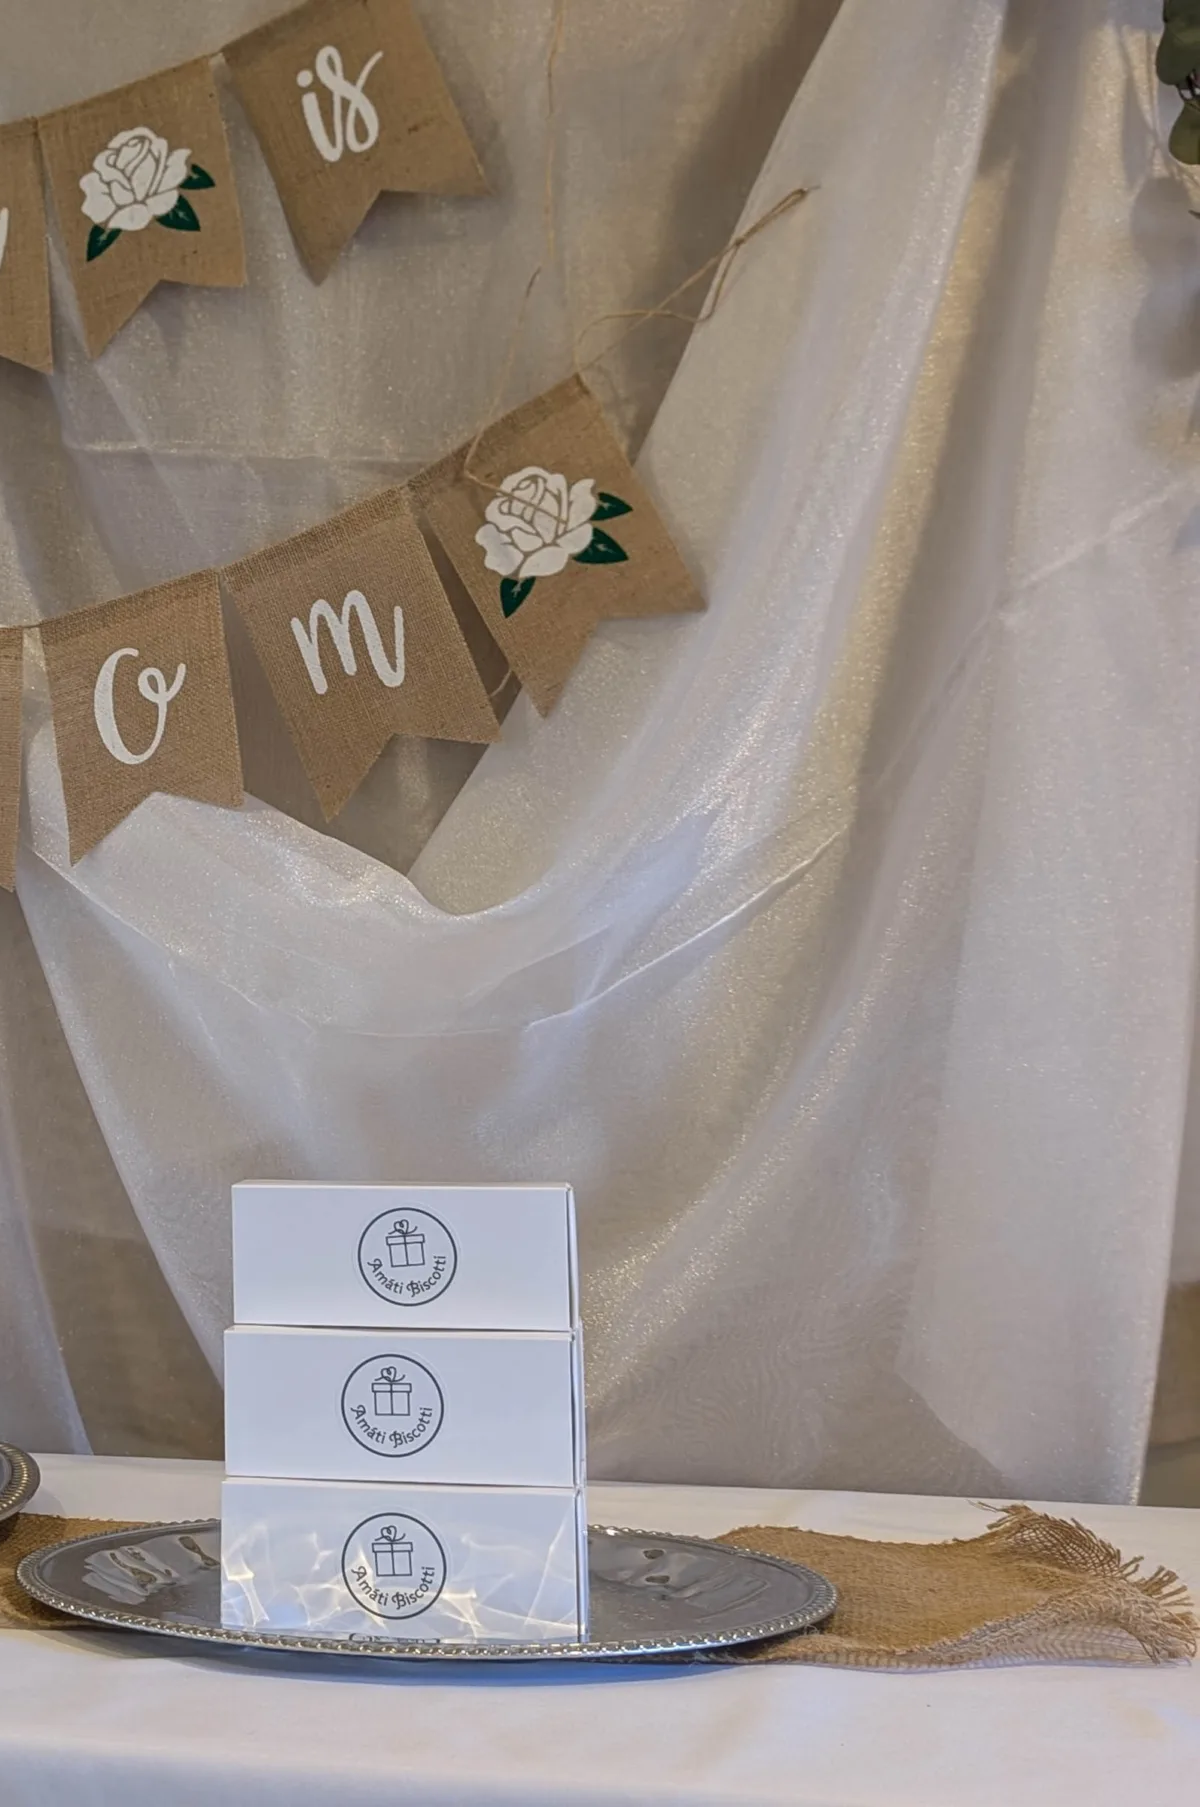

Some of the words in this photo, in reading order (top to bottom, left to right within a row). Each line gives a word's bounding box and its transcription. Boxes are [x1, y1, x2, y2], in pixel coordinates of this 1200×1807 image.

[297, 45, 384, 163] is
[406, 1255, 447, 1298] Biscotti
[389, 1406, 433, 1449] Biscotti
[391, 1566, 435, 1610] Biscotti
